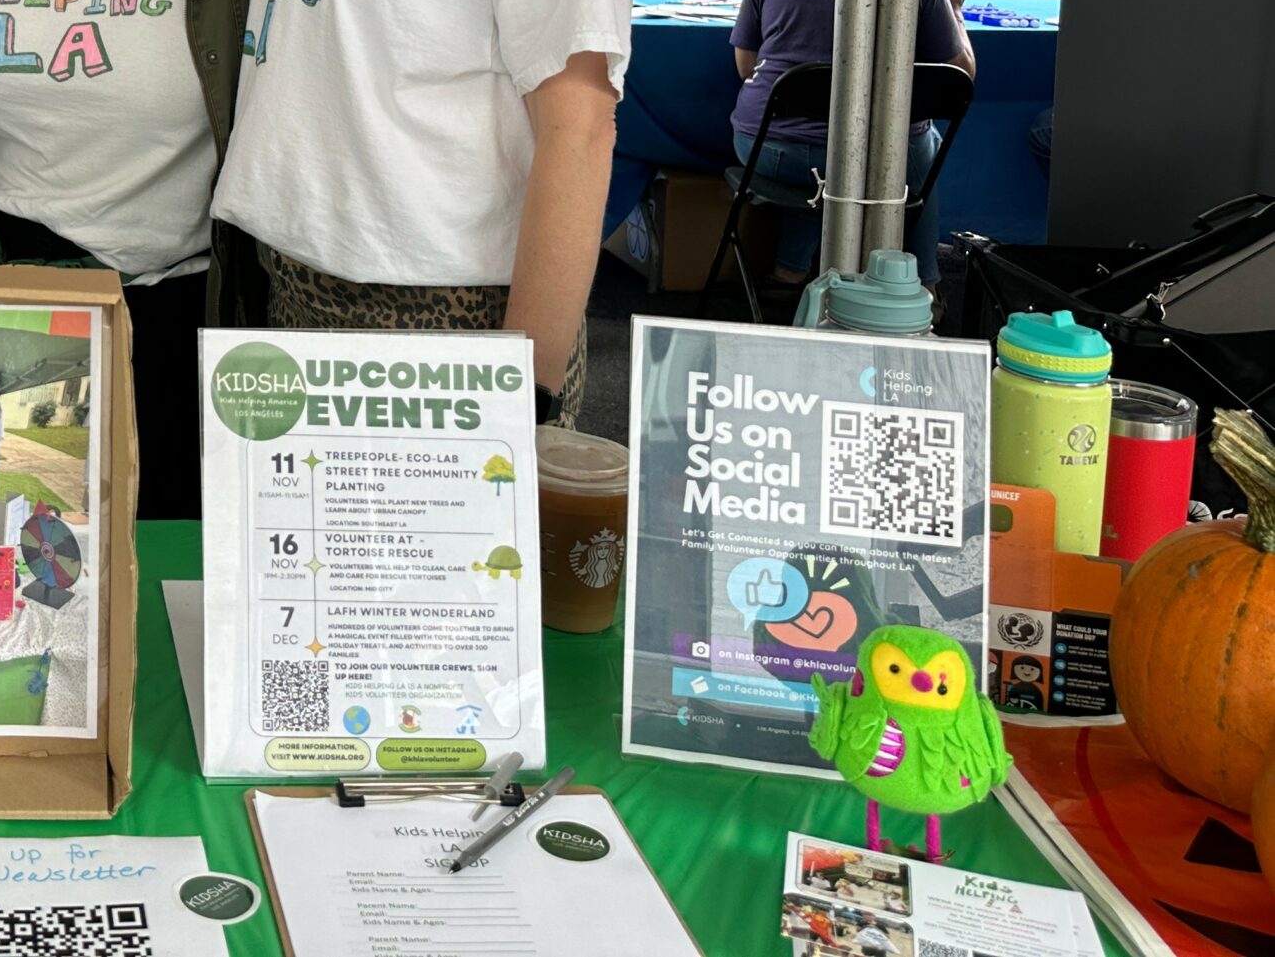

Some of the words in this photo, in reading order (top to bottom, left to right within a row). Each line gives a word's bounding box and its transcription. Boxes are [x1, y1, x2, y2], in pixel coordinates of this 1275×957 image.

[305, 359, 524, 392] UPCOMING
[883, 369, 911, 381] Kids
[216, 372, 306, 394] KIDSHA
[883, 381, 933, 396] Helping
[687, 371, 820, 415] Follow
[883, 392, 900, 403] LA
[238, 396, 266, 407] Helping
[267, 398, 298, 406] America
[250, 410, 284, 418] ANGELES
[306, 395, 482, 431] EVENTS
[686, 407, 733, 445] Us
[741, 424, 792, 450] on
[270, 452, 295, 474] 11
[325, 451, 404, 462] TREEPEOPLE-
[406, 453, 460, 464] ECO-LAB
[684, 443, 801, 487] Social
[325, 466, 369, 477] STREET
[371, 467, 402, 478] TREE
[404, 468, 478, 479] COMMUNITY
[272, 476, 300, 488] NOV
[325, 481, 386, 493] PLANTING
[991, 490, 1021, 501] UNICEF
[325, 497, 369, 506] VOLUNTEERS
[387, 499, 410, 507] PLANT
[411, 499, 427, 507] NEW
[450, 500, 466, 508] AND
[682, 479, 806, 525] Media
[325, 507, 347, 515] LEARN
[348, 507, 372, 515] ABOUT
[397, 508, 427, 516] CANOPY
[269, 533, 299, 555] 16
[325, 533, 395, 544] VOLUNTEER
[397, 535, 414, 545] AT
[682, 528, 706, 537] Let's
[707, 529, 726, 539] Get
[727, 532, 780, 545] Connected
[782, 538, 795, 546] so
[797, 539, 816, 550] you
[819, 543, 838, 551] can
[869, 546, 900, 558] about
[902, 551, 920, 560] the
[922, 552, 952, 564] latest
[325, 547, 385, 558] TORTOISE
[388, 548, 434, 559] RESCUE
[681, 539, 715, 552] Family
[717, 543, 766, 555] Volunteer
[768, 547, 836, 564] Opportunities
[839, 556, 897, 571] throughout
[898, 562, 915, 572] LA!
[271, 558, 299, 570] NOV
[280, 606, 295, 627] 7
[327, 606, 358, 617] LAFH
[360, 607, 407, 618] WINTER
[410, 608, 495, 619] WONDERLAND
[1056, 623, 1072, 631] WHAT
[273, 634, 299, 645] DEC
[1055, 629, 1084, 640] DONATION
[718, 650, 732, 659] on
[735, 651, 790, 666] Instagram
[793, 658, 856, 673] @khlavolun
[335, 663, 346, 671] TO
[348, 663, 370, 671] JOIN
[371, 663, 389, 671] OUR
[390, 663, 440, 672] VOLUNTEER
[442, 664, 475, 673] CREWS,
[477, 664, 498, 672] SIGN
[335, 673, 347, 681] UP
[348, 673, 372, 681] HERE!
[718, 683, 731, 692] on
[734, 684, 786, 699] Facebook
[789, 692, 820, 702] @KHA
[692, 715, 724, 725] KIDSHA
[278, 743, 301, 751] MORE
[301, 743, 358, 752] INFORMATION,
[383, 746, 412, 754] FOLLOW
[435, 747, 478, 755] INSTAGRAM
[272, 753, 292, 761] VISIT
[292, 753, 365, 762] WWW.KIDSHA.ORG
[393, 827, 429, 837] Kids
[432, 827, 487, 840] Helpin
[543, 827, 605, 849] KIDSHA
[66, 843, 102, 864] for
[441, 843, 463, 852] LA
[424, 858, 459, 868] SIG
[184, 878, 237, 909] KIDSHA
